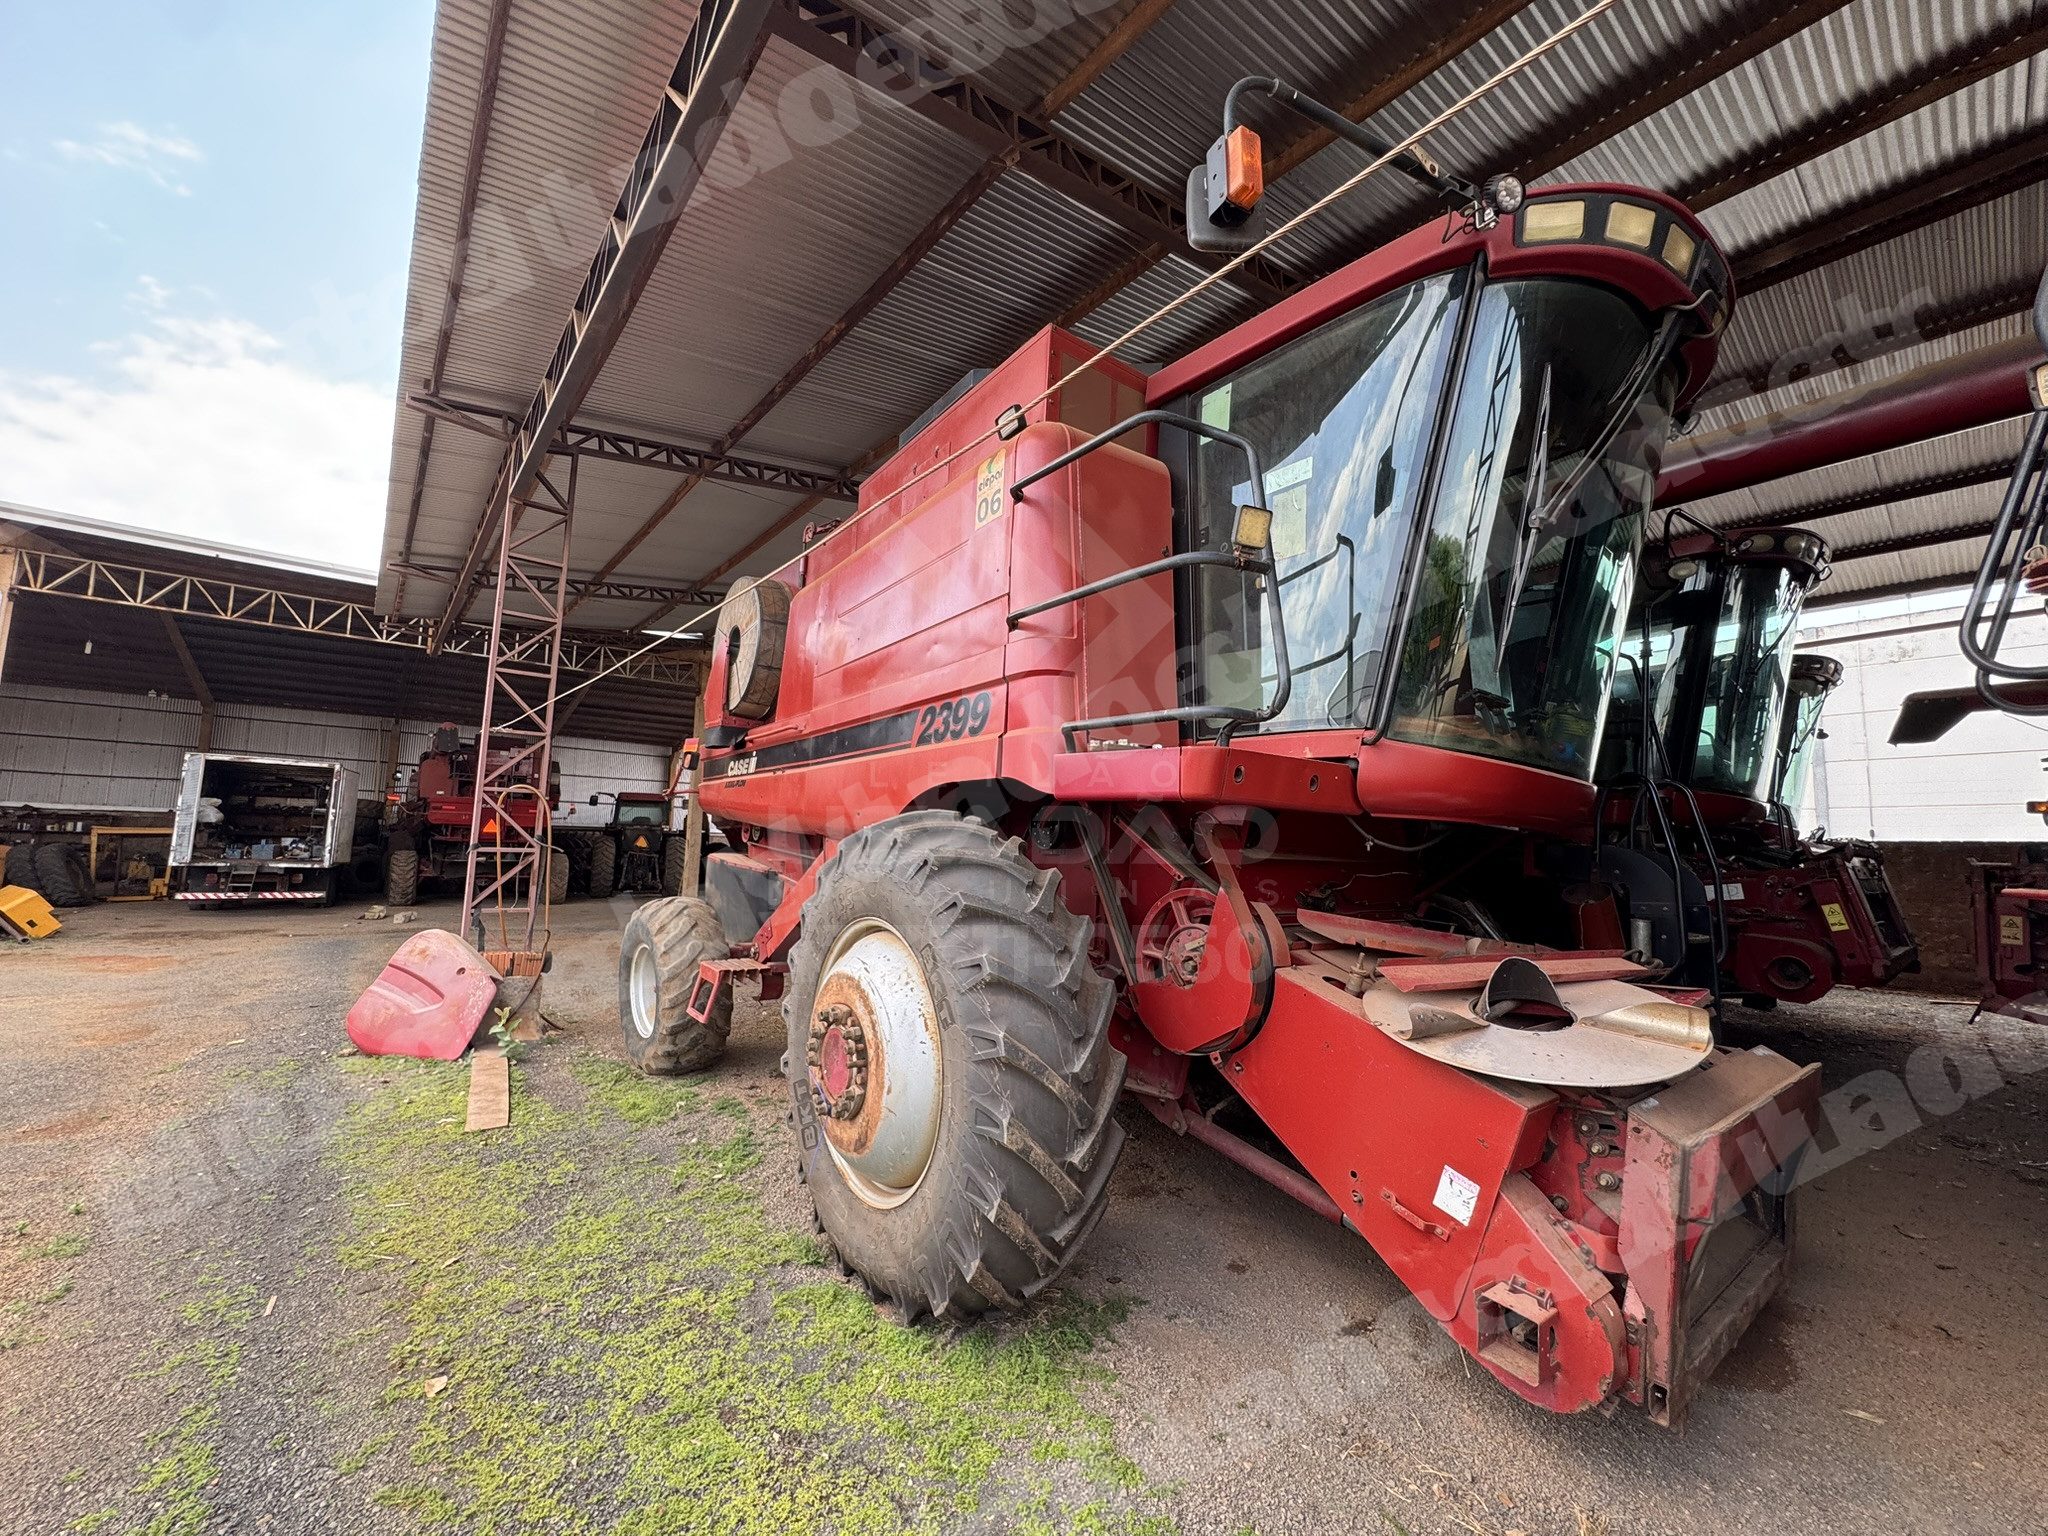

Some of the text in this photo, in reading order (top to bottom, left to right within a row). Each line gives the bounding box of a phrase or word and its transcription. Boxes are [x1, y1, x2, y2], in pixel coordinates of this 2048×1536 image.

[978, 488, 1002, 523] 06
[916, 692, 990, 747] 2399
[727, 757, 749, 777] CASE
